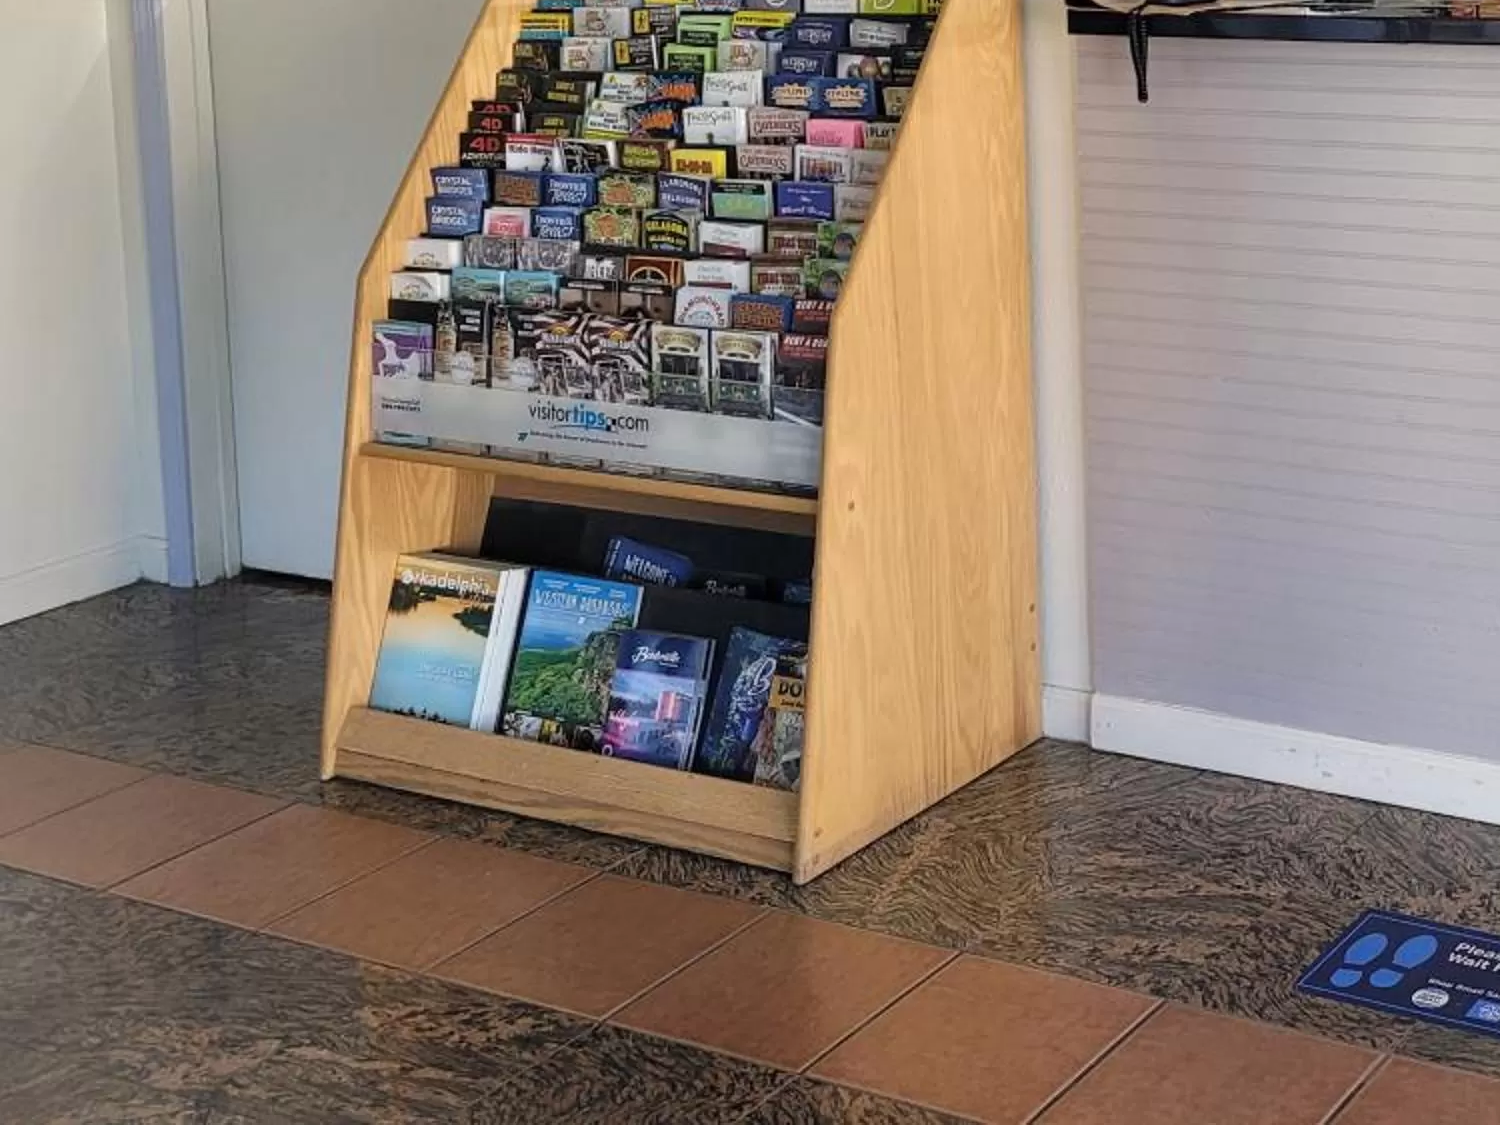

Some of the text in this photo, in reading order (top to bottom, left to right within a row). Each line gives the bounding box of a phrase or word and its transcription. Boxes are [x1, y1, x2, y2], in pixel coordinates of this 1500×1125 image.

[468, 136, 500, 153] 4D
[528, 400, 650, 433] visitortips.com
[623, 554, 669, 583] WELCOME
[1448, 952, 1489, 971] Wait
